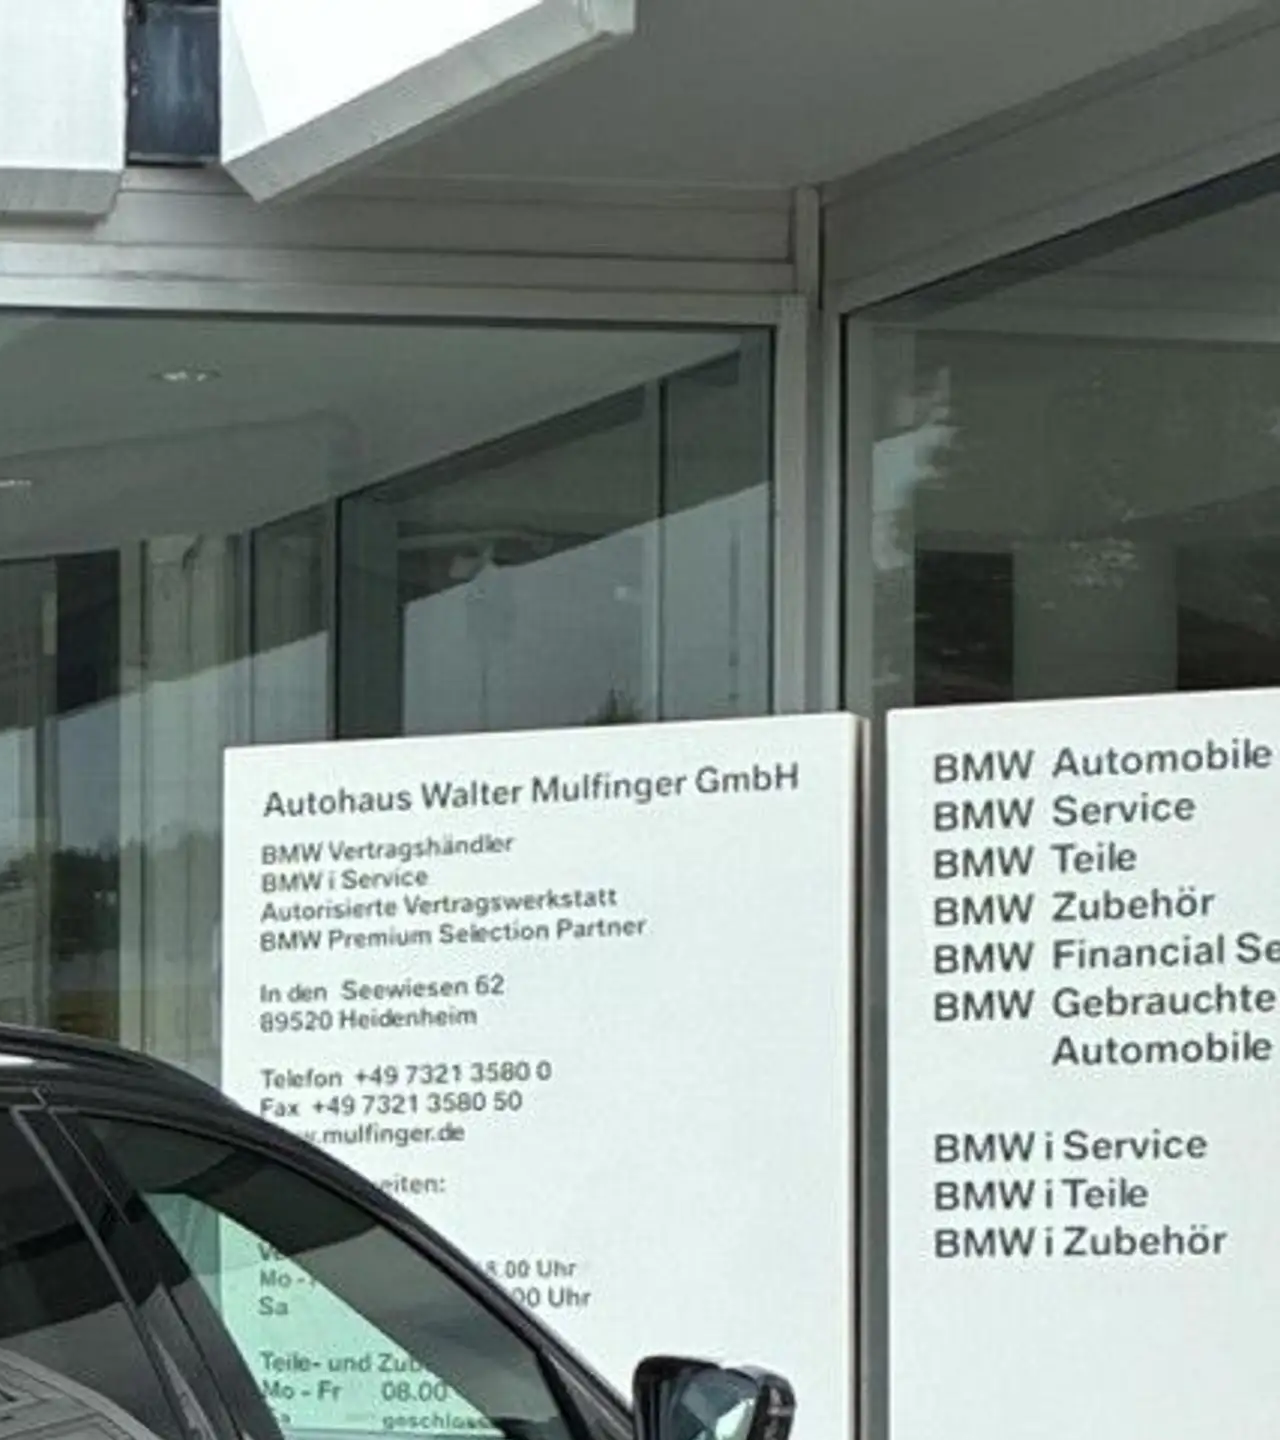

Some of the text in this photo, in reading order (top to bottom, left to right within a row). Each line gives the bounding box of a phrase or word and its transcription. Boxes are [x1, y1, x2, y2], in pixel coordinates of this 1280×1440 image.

[933, 737, 1273, 785] BMW Automobile
[262, 761, 799, 818] Autohaus Walter Mulfinger GmbH
[933, 791, 1197, 833] BMW Service
[261, 833, 515, 866] BMW Vertragshändler
[933, 840, 1138, 880] BMW Teile
[260, 871, 324, 895] BMW
[340, 867, 429, 891] Service
[259, 887, 618, 924] Autorisierte Vertragswerkstatt
[933, 885, 1216, 927] BMW Zubehör
[259, 917, 648, 953] BMW Premium Selection Partner
[933, 940, 1035, 975] BMW
[1052, 933, 1225, 971] Financial
[259, 972, 505, 1004] In den Seewiesen 62
[933, 982, 1277, 1023] BMW Gebrauchte
[259, 1005, 478, 1034] 89520 Heidenheim
[1051, 1029, 1273, 1067] Automobile
[259, 1059, 553, 1090] Telefon +49 7321 3580 0
[259, 1089, 524, 1119] Fax +49 7321 3580 50
[302, 1122, 466, 1148] w.mulfinger.de
[934, 1127, 1208, 1164] BMW i Service
[934, 1176, 1149, 1212] BMW i Teile
[934, 1223, 1229, 1259] BMW i Zubehör
